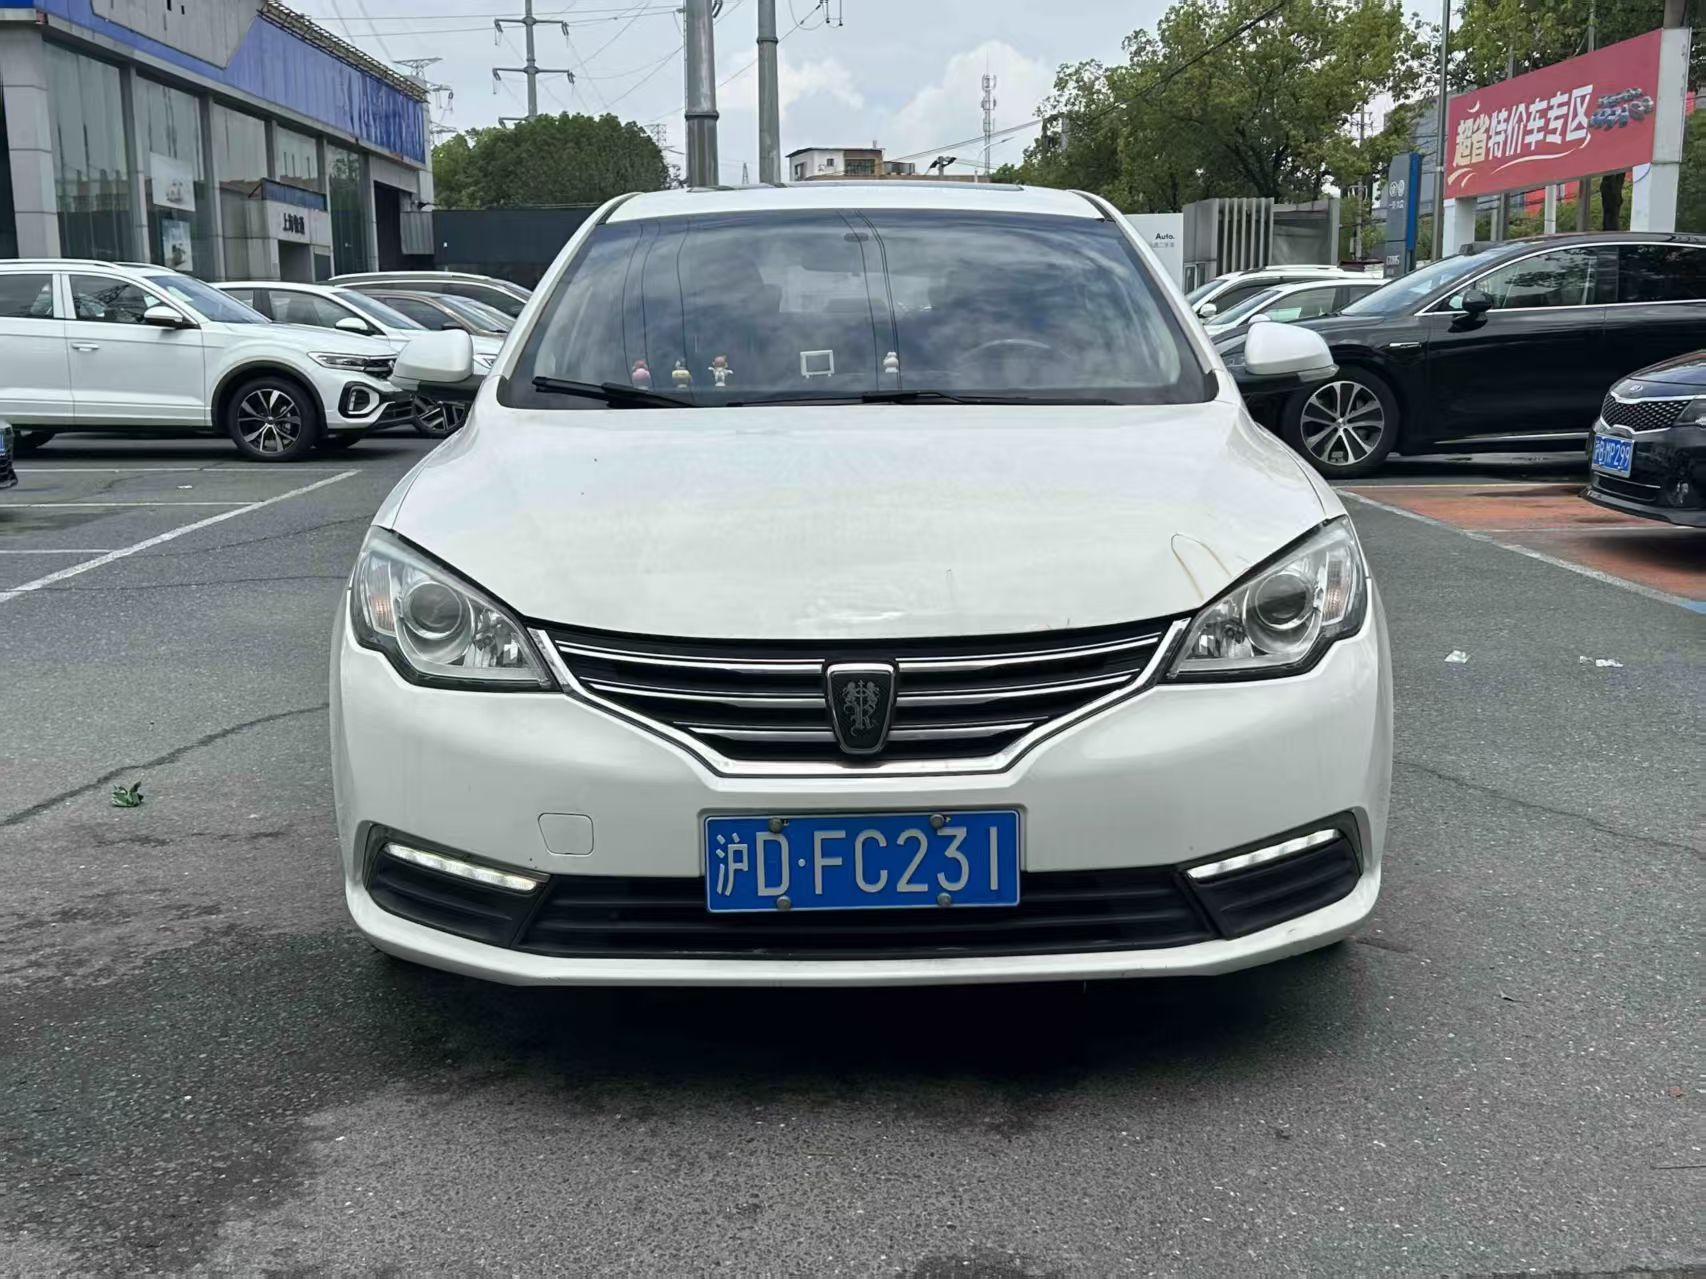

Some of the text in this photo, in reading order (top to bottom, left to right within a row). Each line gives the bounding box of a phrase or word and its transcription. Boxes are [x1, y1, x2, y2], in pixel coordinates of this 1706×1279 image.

[1452, 84, 1593, 167] 超省特价车专区
[716, 826, 998, 896] 沪D·FC231
